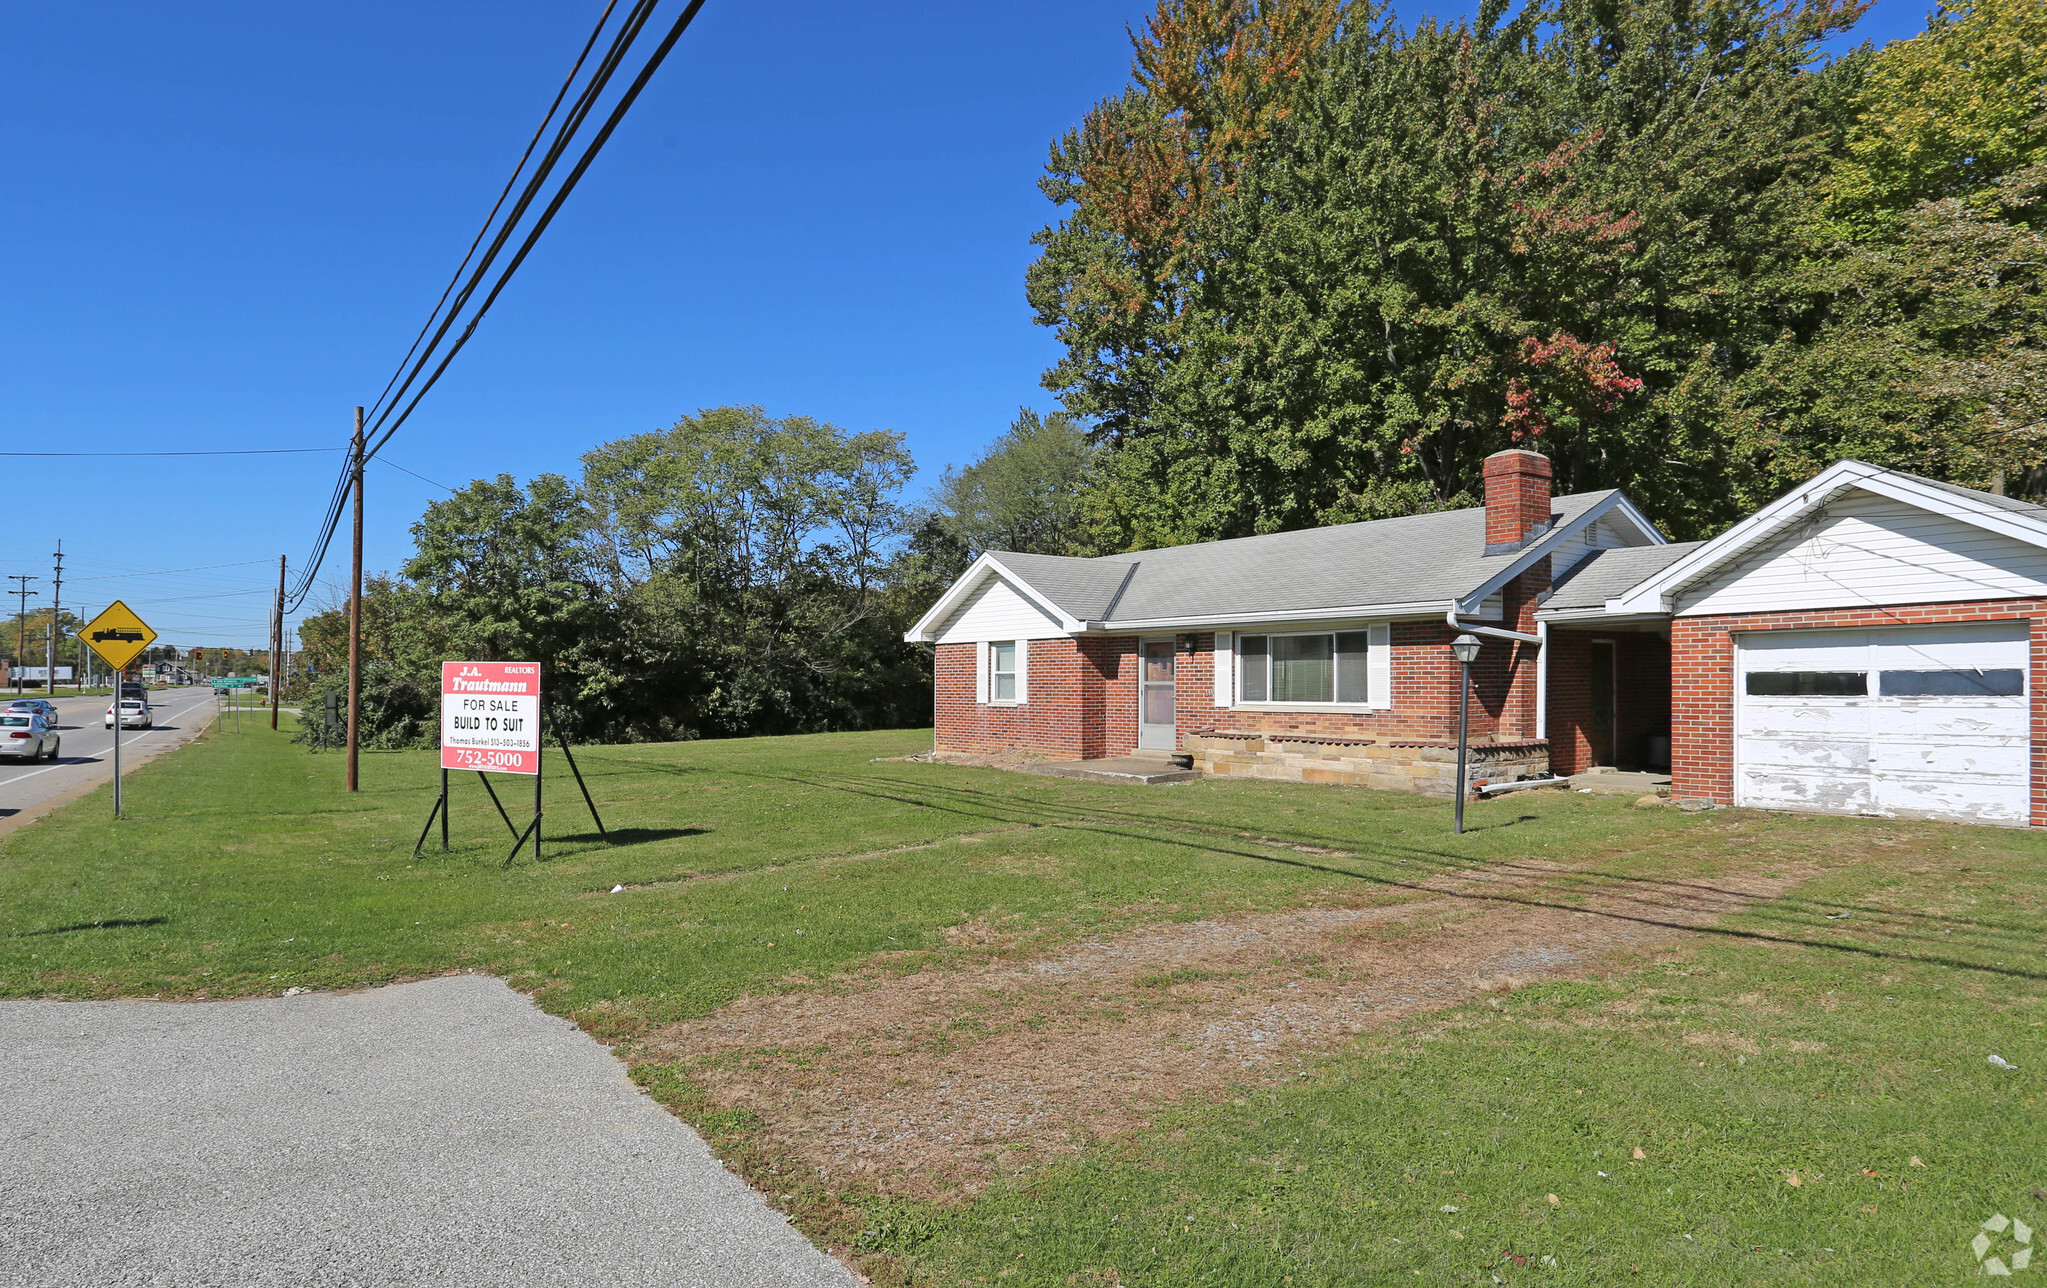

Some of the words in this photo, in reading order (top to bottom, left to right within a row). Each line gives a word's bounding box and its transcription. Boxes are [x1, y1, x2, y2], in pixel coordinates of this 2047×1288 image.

[459, 666, 482, 677] J.A.
[504, 666, 535, 674] REALTORS
[452, 677, 527, 692] Trautmann
[463, 699, 485, 711] FOR
[489, 700, 518, 712] SALE
[454, 716, 480, 730] BUILD
[485, 717, 498, 731] TO
[503, 718, 523, 731] SUIT
[450, 736, 471, 745] Thomas
[491, 738, 530, 748] 513-503-1856
[456, 750, 522, 767] 752-5000
